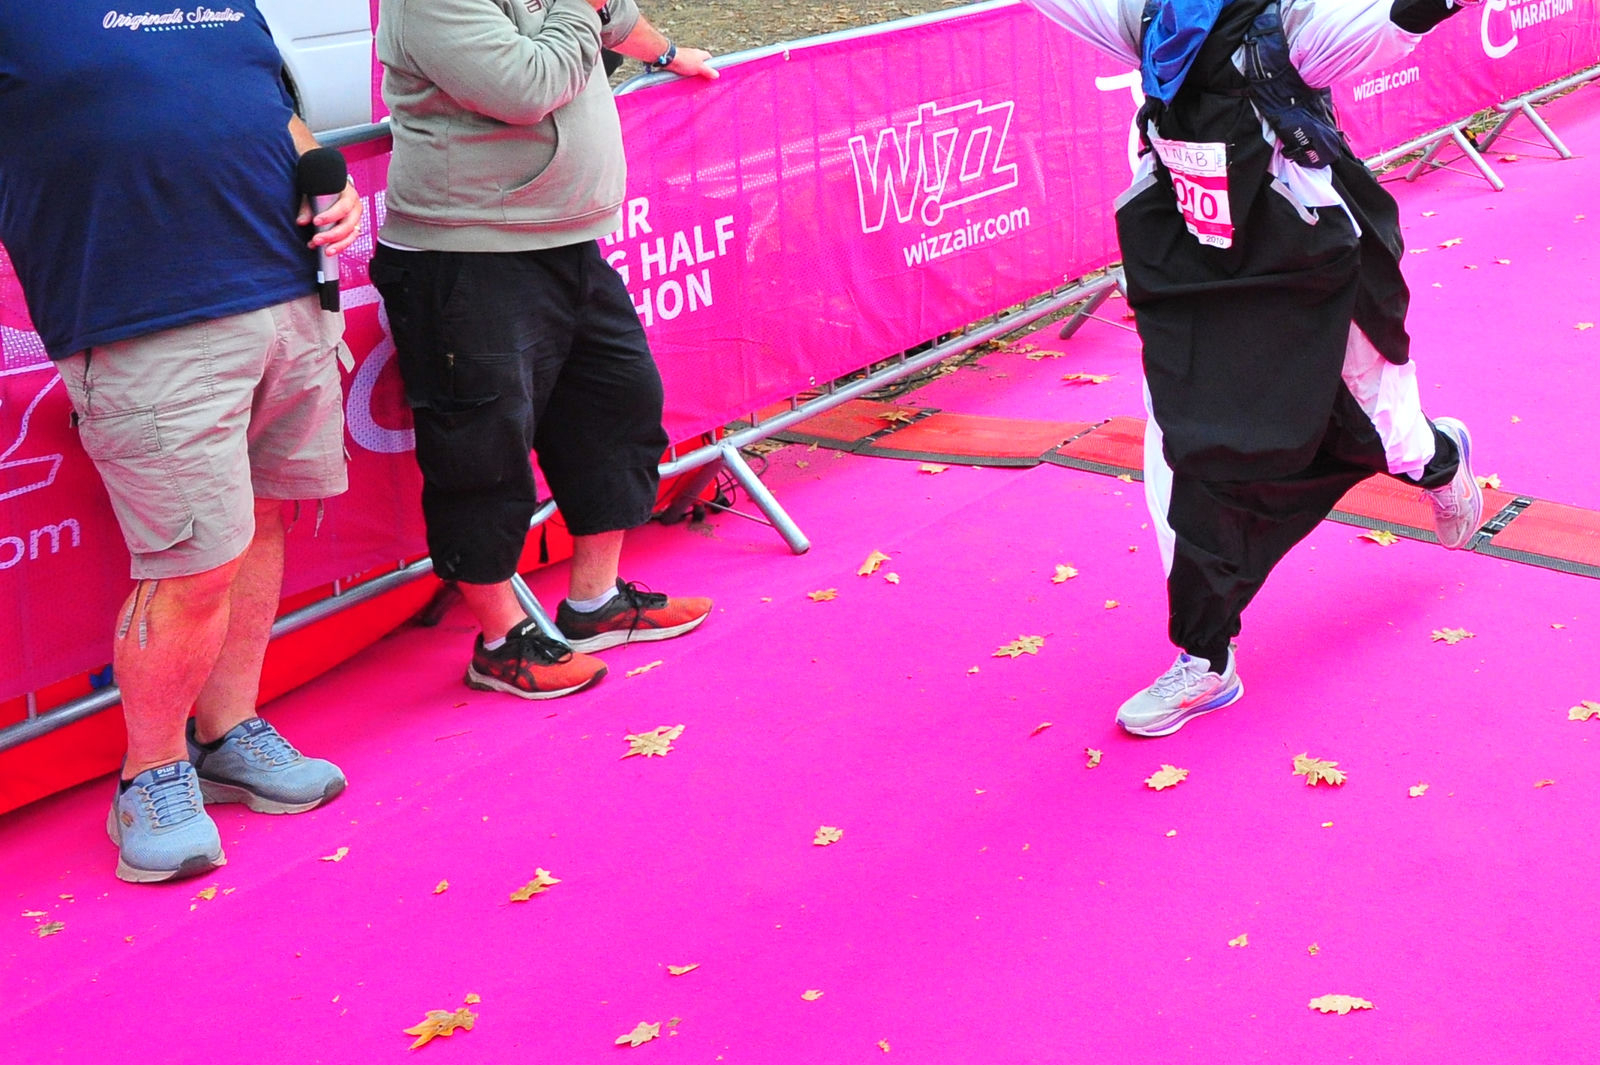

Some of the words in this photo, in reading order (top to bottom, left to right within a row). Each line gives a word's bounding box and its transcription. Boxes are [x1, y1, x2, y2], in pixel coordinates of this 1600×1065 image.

[103, 8, 183, 30] Originals
[186, 6, 245, 23] Studio
[1353, 66, 1420, 102] wizzair.com
[599, 197, 652, 246] IR
[903, 206, 1030, 267] wizzair.com
[1206, 236, 1224, 246] 2010
[640, 215, 734, 281] HALF
